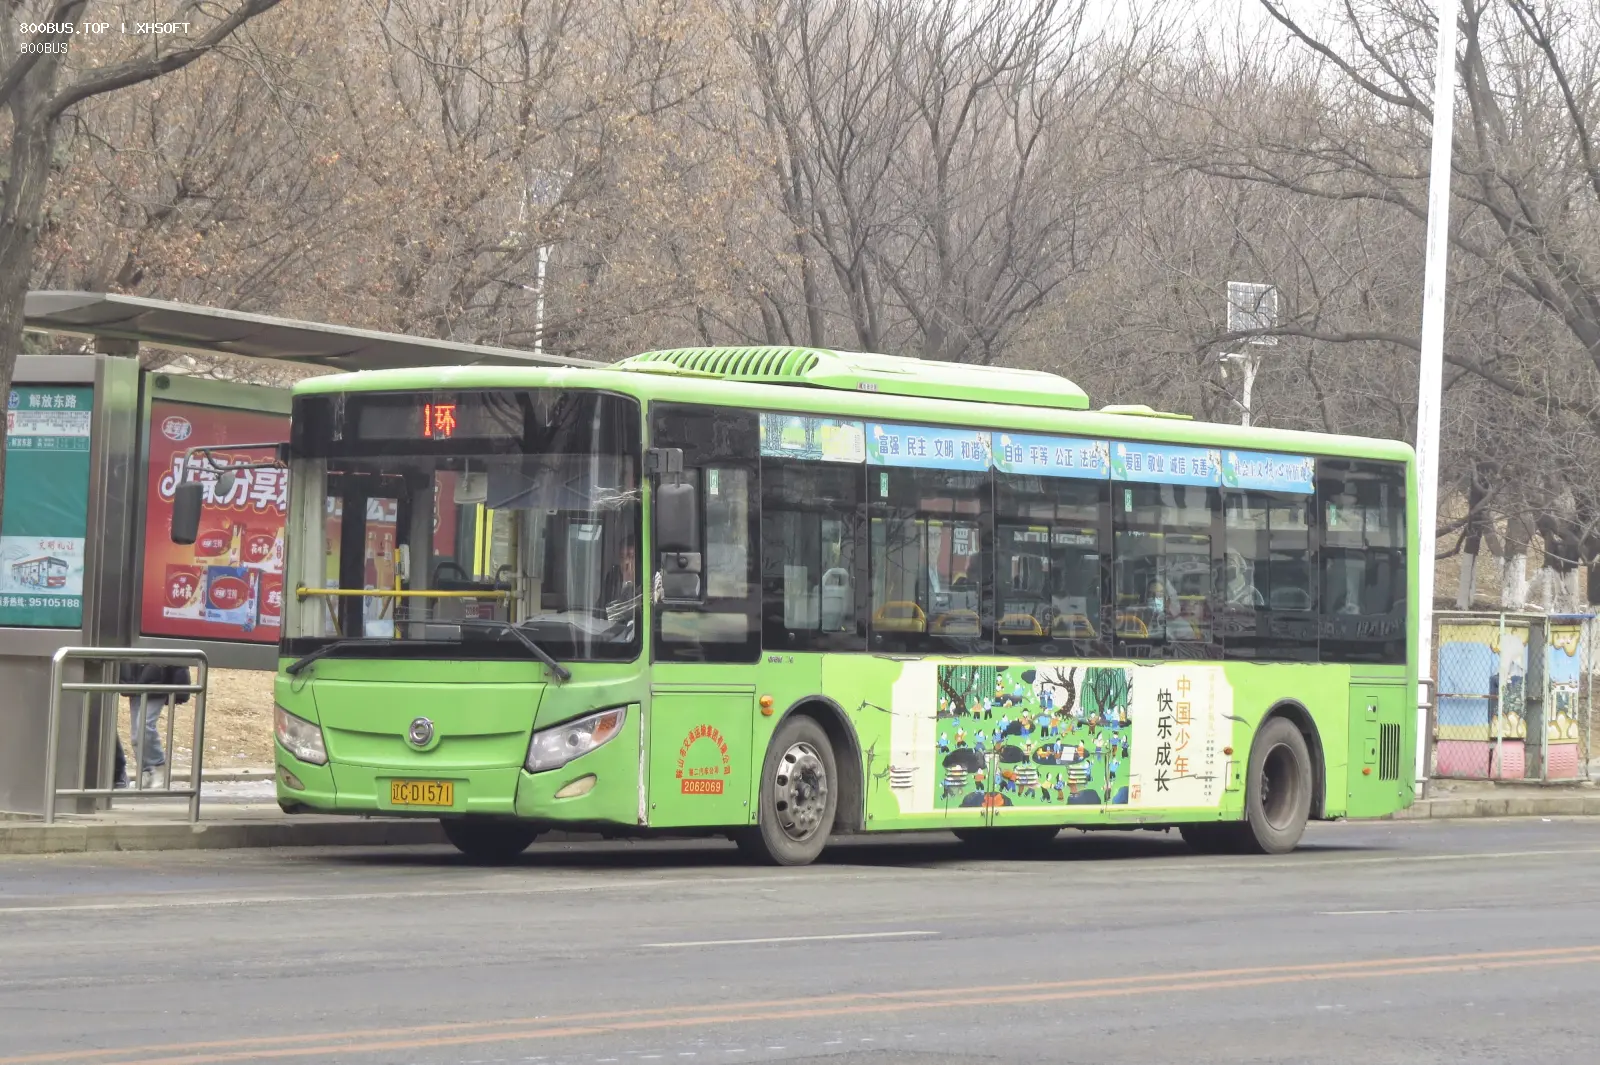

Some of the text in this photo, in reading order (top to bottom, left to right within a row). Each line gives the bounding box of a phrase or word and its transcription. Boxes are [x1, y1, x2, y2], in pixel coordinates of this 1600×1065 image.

[29, 394, 77, 409] 解放东路
[424, 404, 456, 436] 1环
[880, 435, 899, 455] 富强
[907, 437, 926, 457] 民主
[934, 439, 954, 458] 文明
[961, 440, 980, 460] 和谐
[1005, 444, 1098, 468] 自由 平等 公正 法治
[1126, 453, 1207, 476] 爱国 敬业 诚信 友善
[0, 596, 80, 608] 务热线: 95105188
[1173, 674, 1191, 778] 中国少年
[1154, 688, 1173, 792] 快乐成长
[684, 781, 721, 793] 2062069
